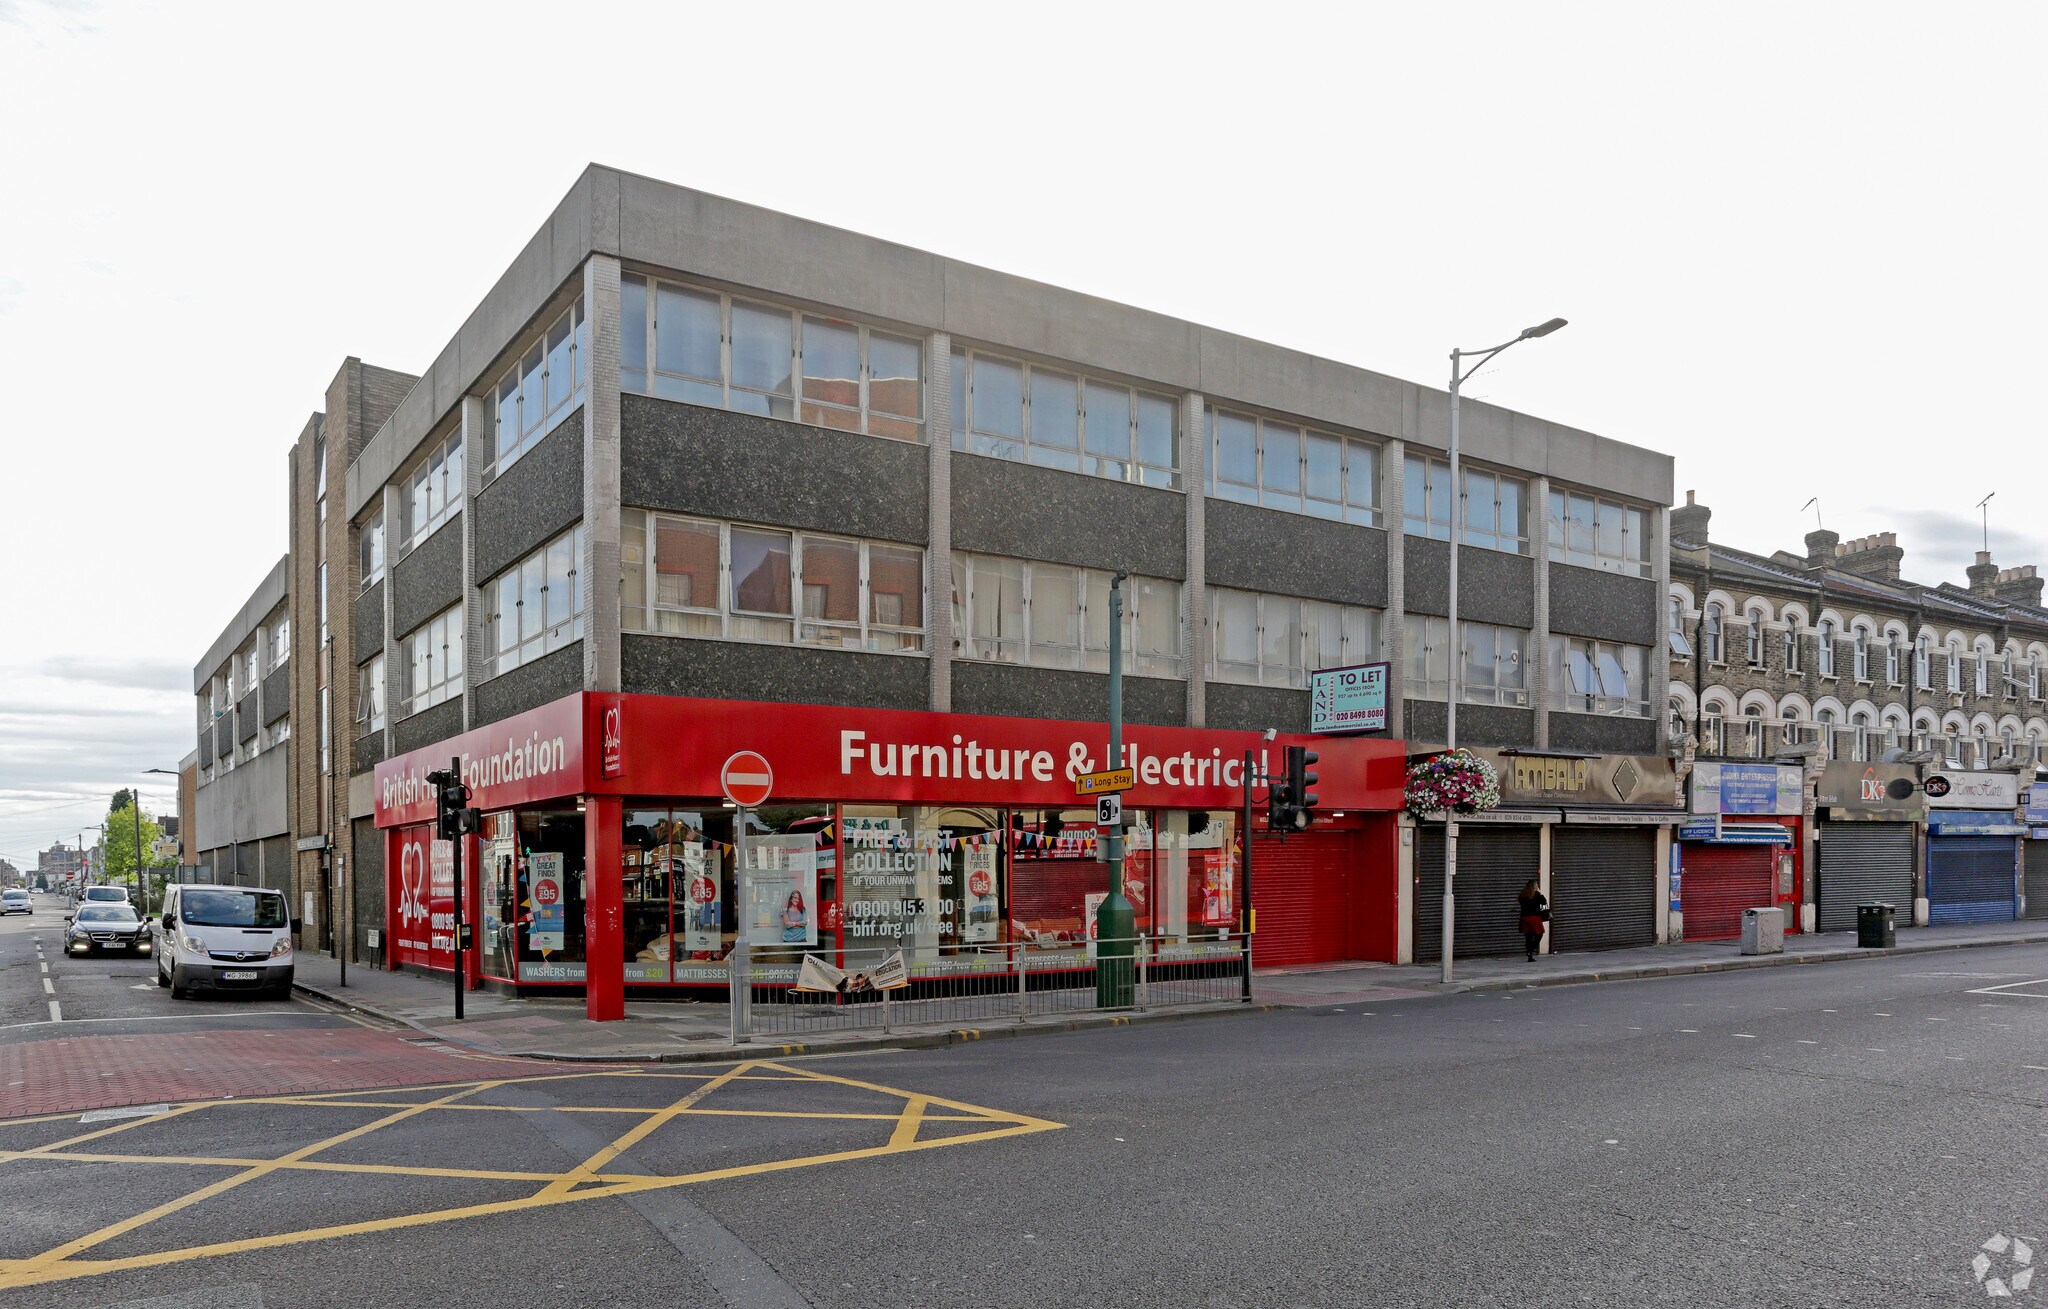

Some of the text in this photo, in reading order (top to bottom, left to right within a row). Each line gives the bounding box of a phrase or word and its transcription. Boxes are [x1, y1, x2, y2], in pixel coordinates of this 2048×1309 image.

[1339, 671, 1382, 685] TO LET
[1336, 708, 1384, 721] 020 8498 8080
[840, 729, 1054, 782] Furniture
[1065, 741, 1095, 782] &
[382, 767, 418, 810] British
[461, 730, 565, 790] Foundation
[1514, 756, 1586, 791] AMBALA
[1094, 778, 1112, 787] Long
[1114, 775, 1131, 784] Stay
[853, 829, 953, 849] FREE & FAST
[853, 852, 952, 872] COLLECTION
[970, 853, 989, 861] GREAT
[536, 862, 556, 870] GREAT
[969, 861, 991, 869] PRICES
[853, 876, 864, 886] OF
[864, 876, 887, 886] YOUR
[972, 880, 988, 891] £65
[538, 889, 555, 900] £95
[853, 901, 892, 918] 0800
[893, 900, 916, 917] 915
[852, 921, 954, 938] bhf.org.uk/free
[526, 967, 585, 977] WASHERS from
[625, 967, 663, 978] from £20
[676, 968, 727, 979] MATTRESSES
[875, 962, 902, 977] EDUCATION
